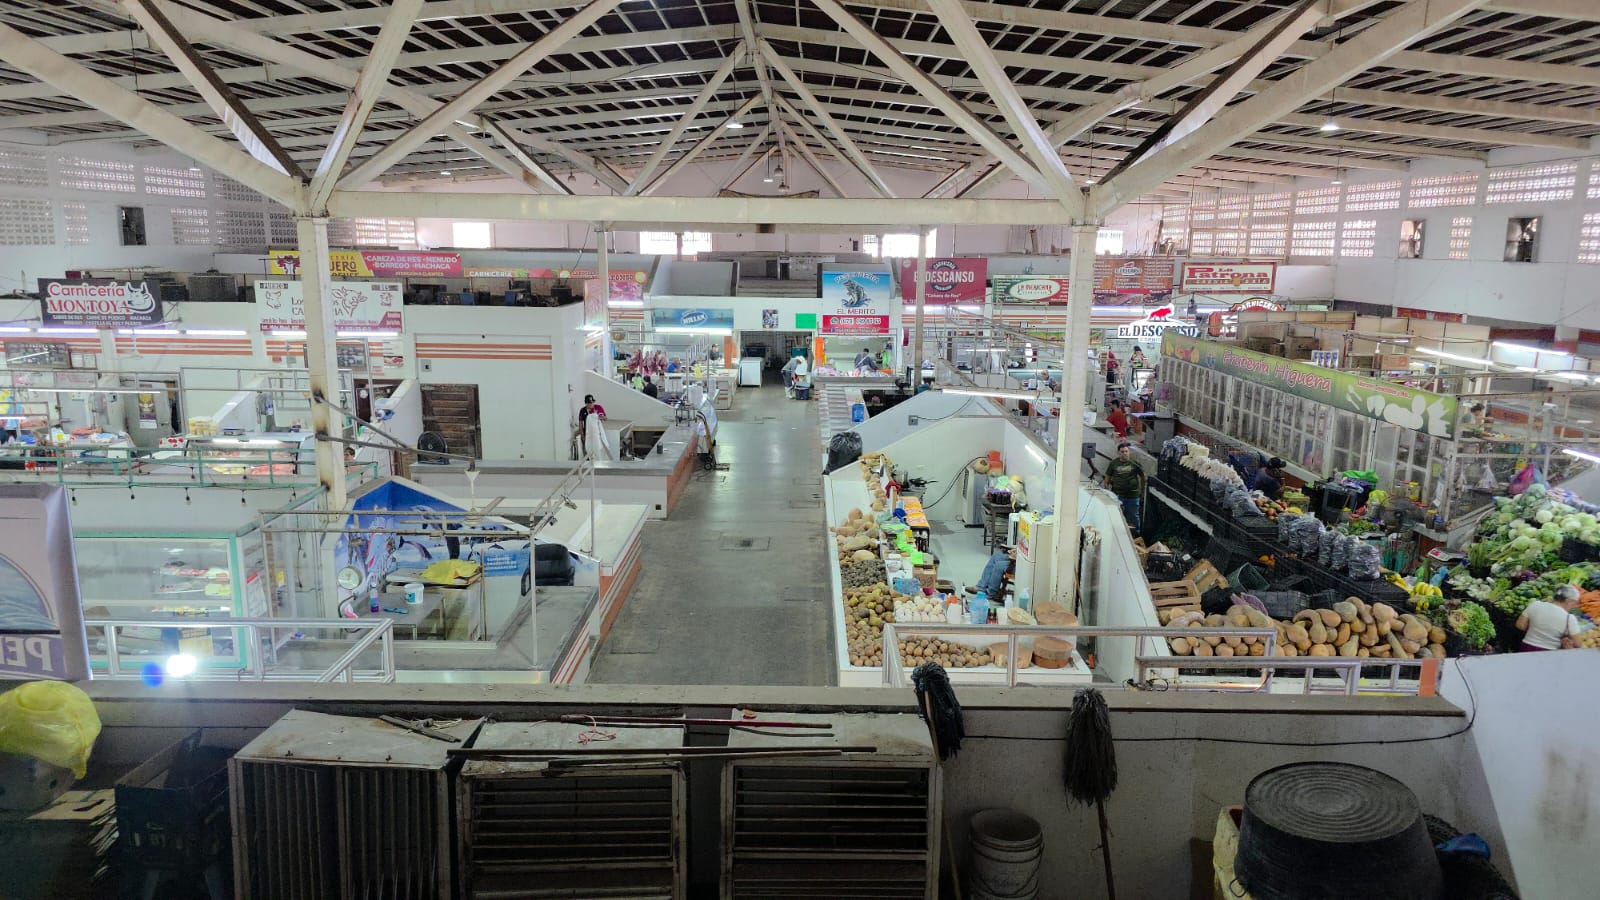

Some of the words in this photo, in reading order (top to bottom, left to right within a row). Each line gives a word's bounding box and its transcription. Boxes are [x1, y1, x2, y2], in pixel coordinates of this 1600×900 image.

[329, 261, 357, 272] JERO
[1187, 267, 1269, 279] Patrona
[925, 271, 975, 283] DESCANSO
[49, 282, 125, 297] Carnicería
[49, 299, 131, 313] MONTOYA
[1119, 327, 1131, 337] EL
[1132, 325, 1198, 338] DESCSO
[1275, 361, 1332, 392] Higuera
